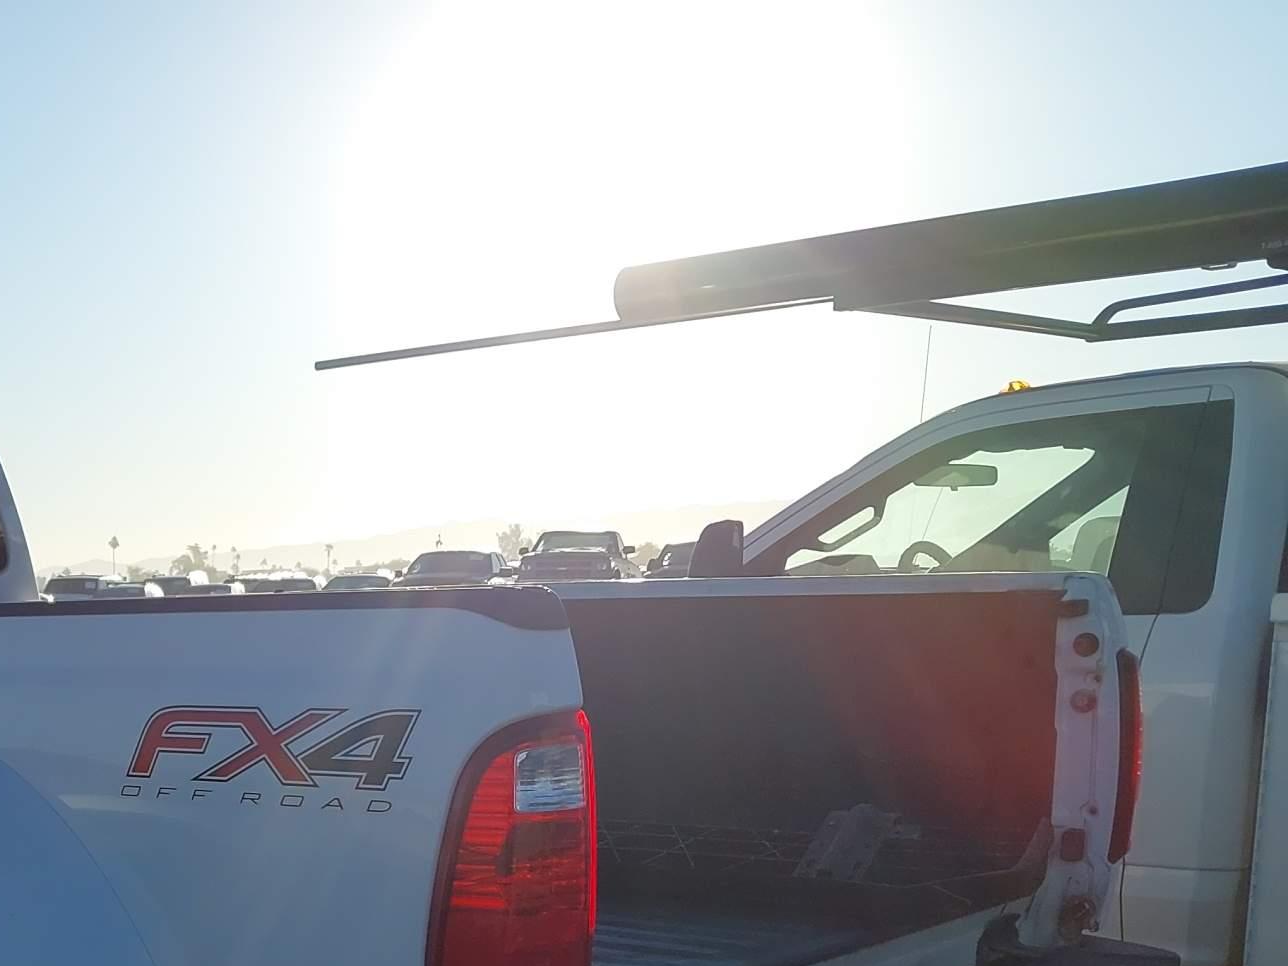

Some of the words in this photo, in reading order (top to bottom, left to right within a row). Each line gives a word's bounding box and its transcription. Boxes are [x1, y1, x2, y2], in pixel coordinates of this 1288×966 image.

[126, 705, 422, 791] FX4
[120, 785, 213, 801] OFF
[240, 792, 392, 813] ROAD
